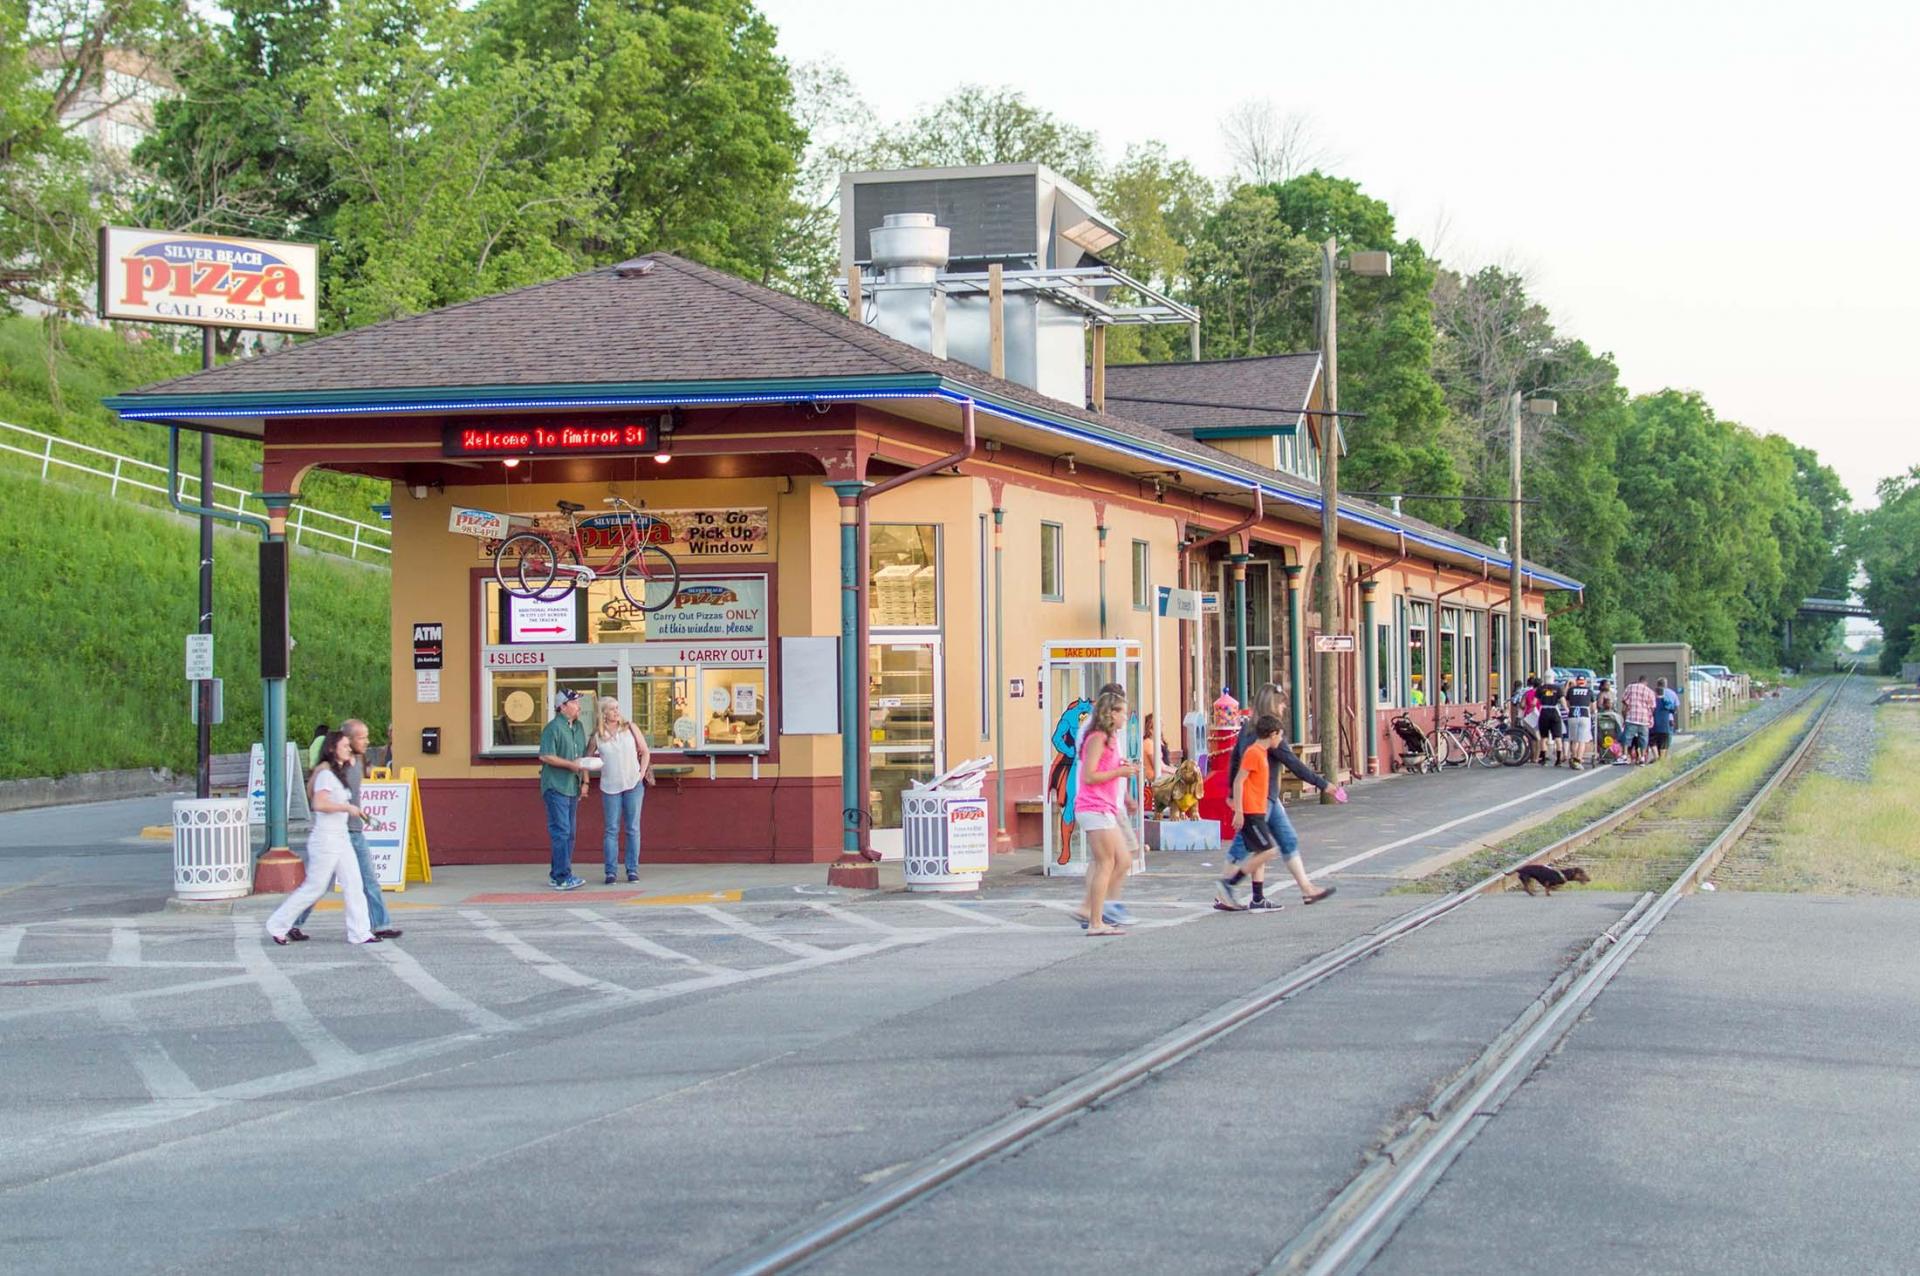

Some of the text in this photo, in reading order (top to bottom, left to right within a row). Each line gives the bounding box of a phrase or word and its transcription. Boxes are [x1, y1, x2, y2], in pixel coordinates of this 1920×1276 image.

[164, 244, 263, 266] SILVER BEACH
[155, 301, 207, 318] CALL
[695, 511, 748, 524] To Go
[689, 526, 753, 540] Pick Up
[689, 541, 754, 554] Window
[653, 609, 758, 621] Carry Out Pizzas ONLY
[414, 626, 442, 640] ATM
[659, 624, 668, 634] at
[670, 622, 686, 634] this
[726, 621, 754, 635] please
[497, 653, 537, 664] SLICES
[688, 650, 755, 661] CARRY OUT
[1064, 648, 1102, 657] TAKE OUT
[363, 806, 388, 816] OUT
